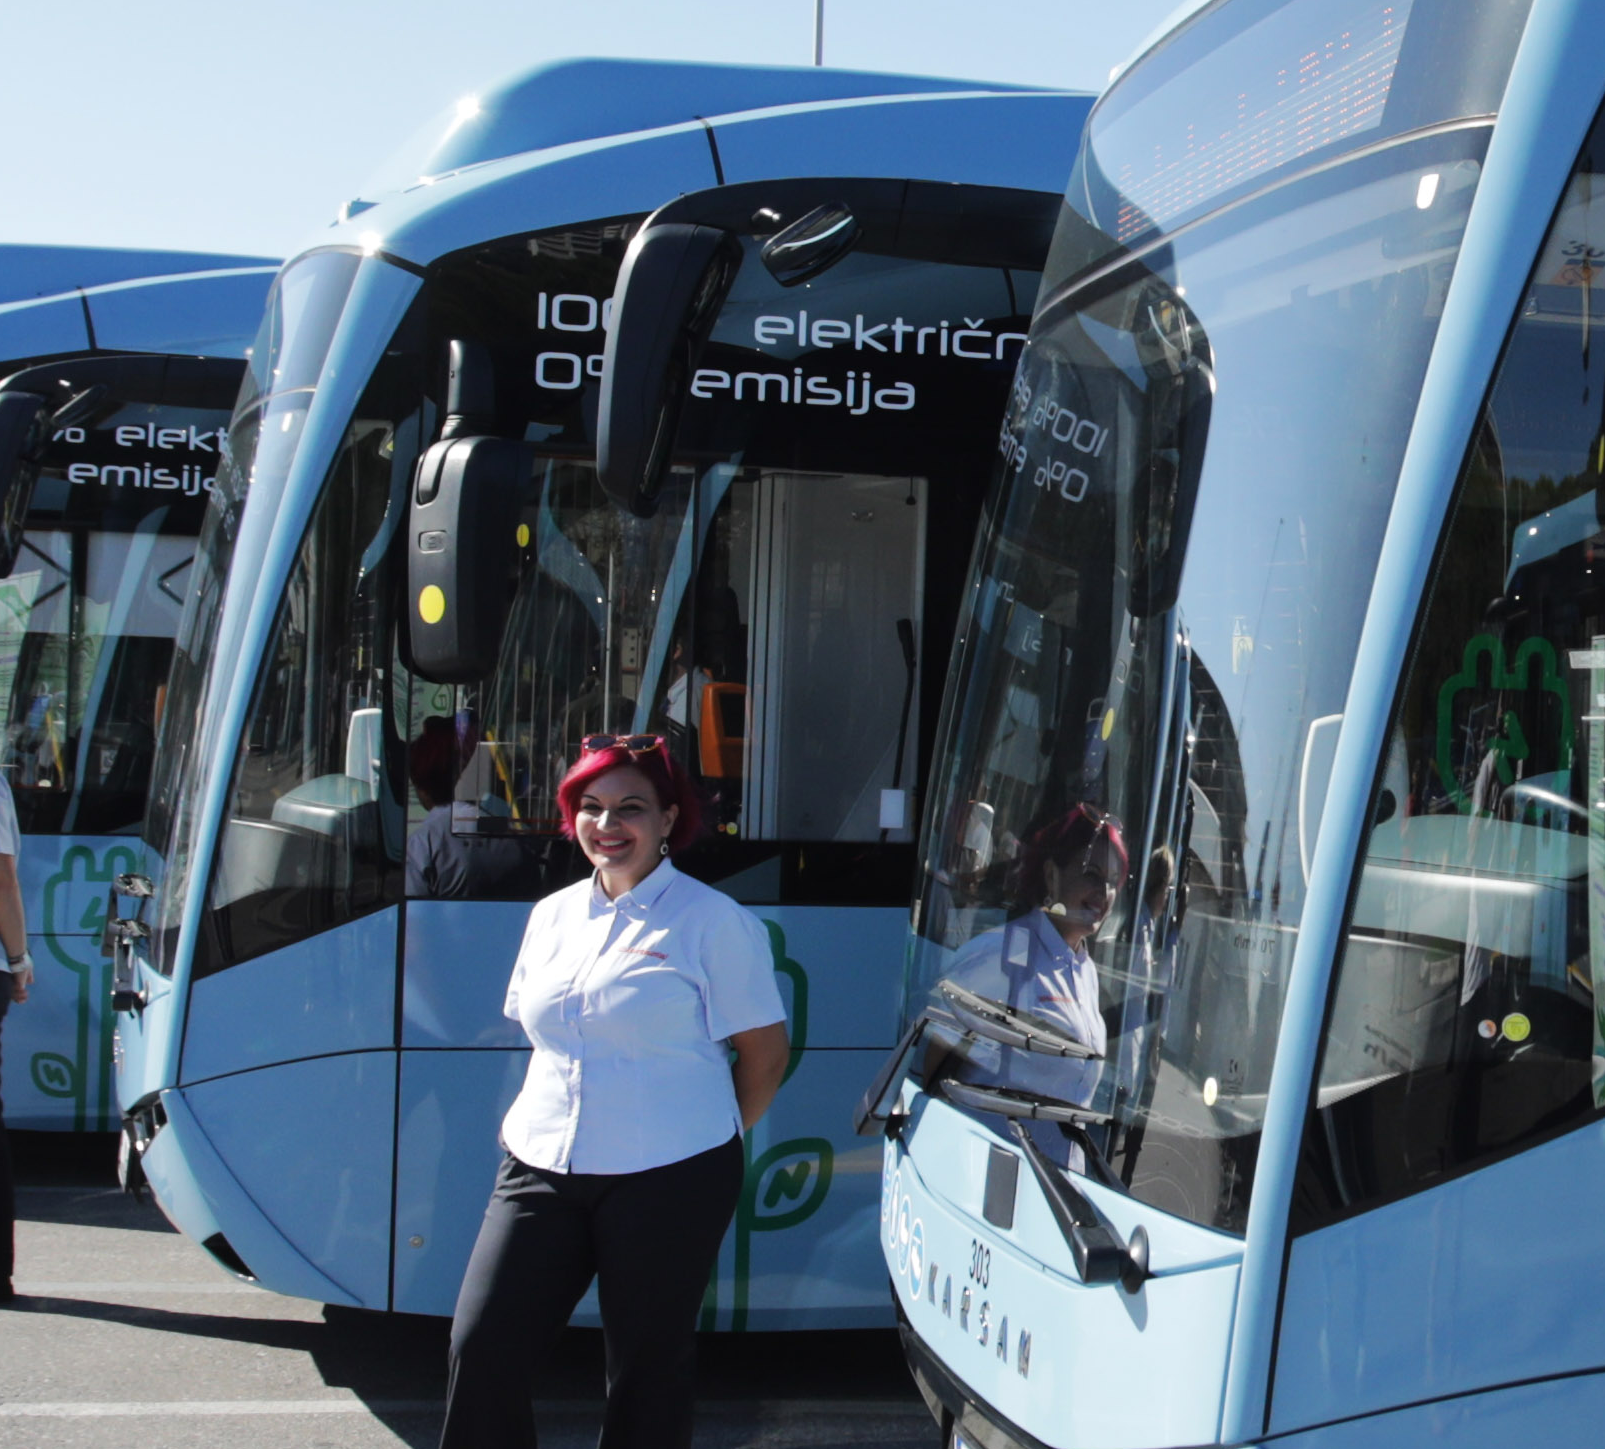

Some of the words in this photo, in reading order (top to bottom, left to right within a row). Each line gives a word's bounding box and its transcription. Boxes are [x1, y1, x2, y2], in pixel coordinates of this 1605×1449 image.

[690, 367, 916, 416] emisija
[968, 1238, 992, 1290] 303
[927, 1261, 1032, 1380] KARSAN
